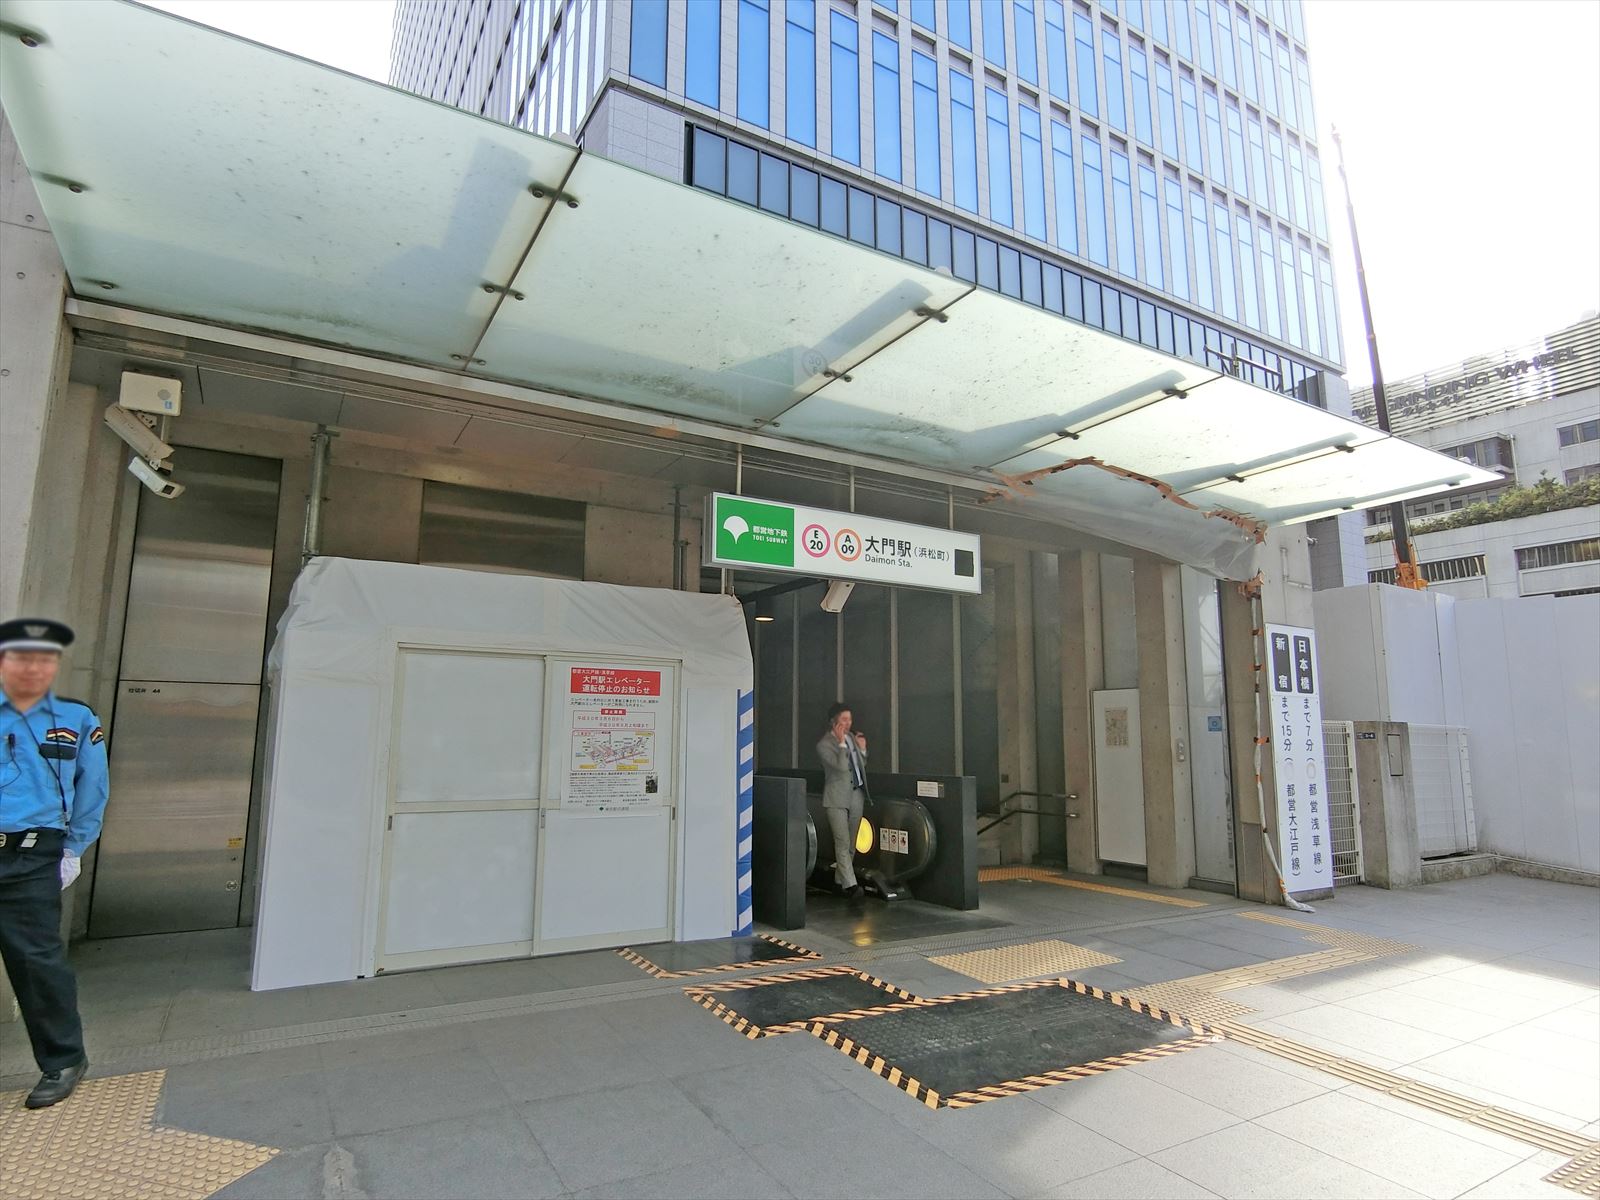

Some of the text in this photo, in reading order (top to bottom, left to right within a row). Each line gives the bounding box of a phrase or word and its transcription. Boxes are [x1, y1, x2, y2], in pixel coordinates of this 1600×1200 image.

[753, 525, 788, 537] 都営地下鉄
[814, 530, 819, 539] E
[766, 536, 788, 545] SUBWAY
[844, 534, 851, 543] A
[810, 540, 824, 551] 20
[841, 544, 855, 555] 09
[865, 554, 913, 568] Daimon Sta.
[1275, 637, 1288, 689] 新宿
[1298, 640, 1310, 690] 日本橋
[582, 675, 651, 685] 大門駅エレベーター
[582, 684, 651, 694] 運転停止のお知らせ
